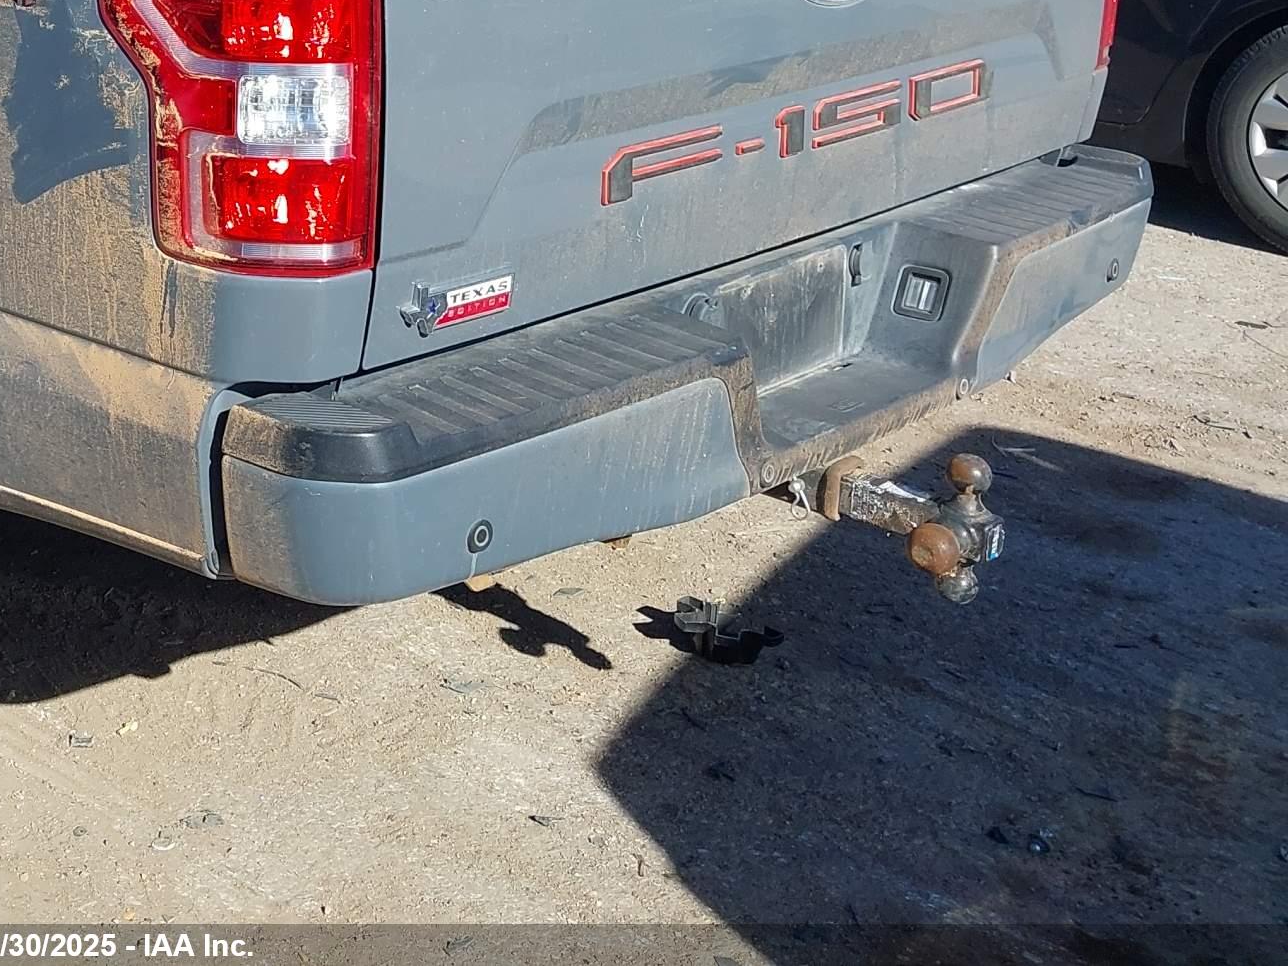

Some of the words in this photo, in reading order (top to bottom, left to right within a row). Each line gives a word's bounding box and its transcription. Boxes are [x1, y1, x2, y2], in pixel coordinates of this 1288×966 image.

[600, 57, 993, 207] F-150
[449, 280, 508, 305] TEXAS
[447, 294, 507, 319] EDITION
